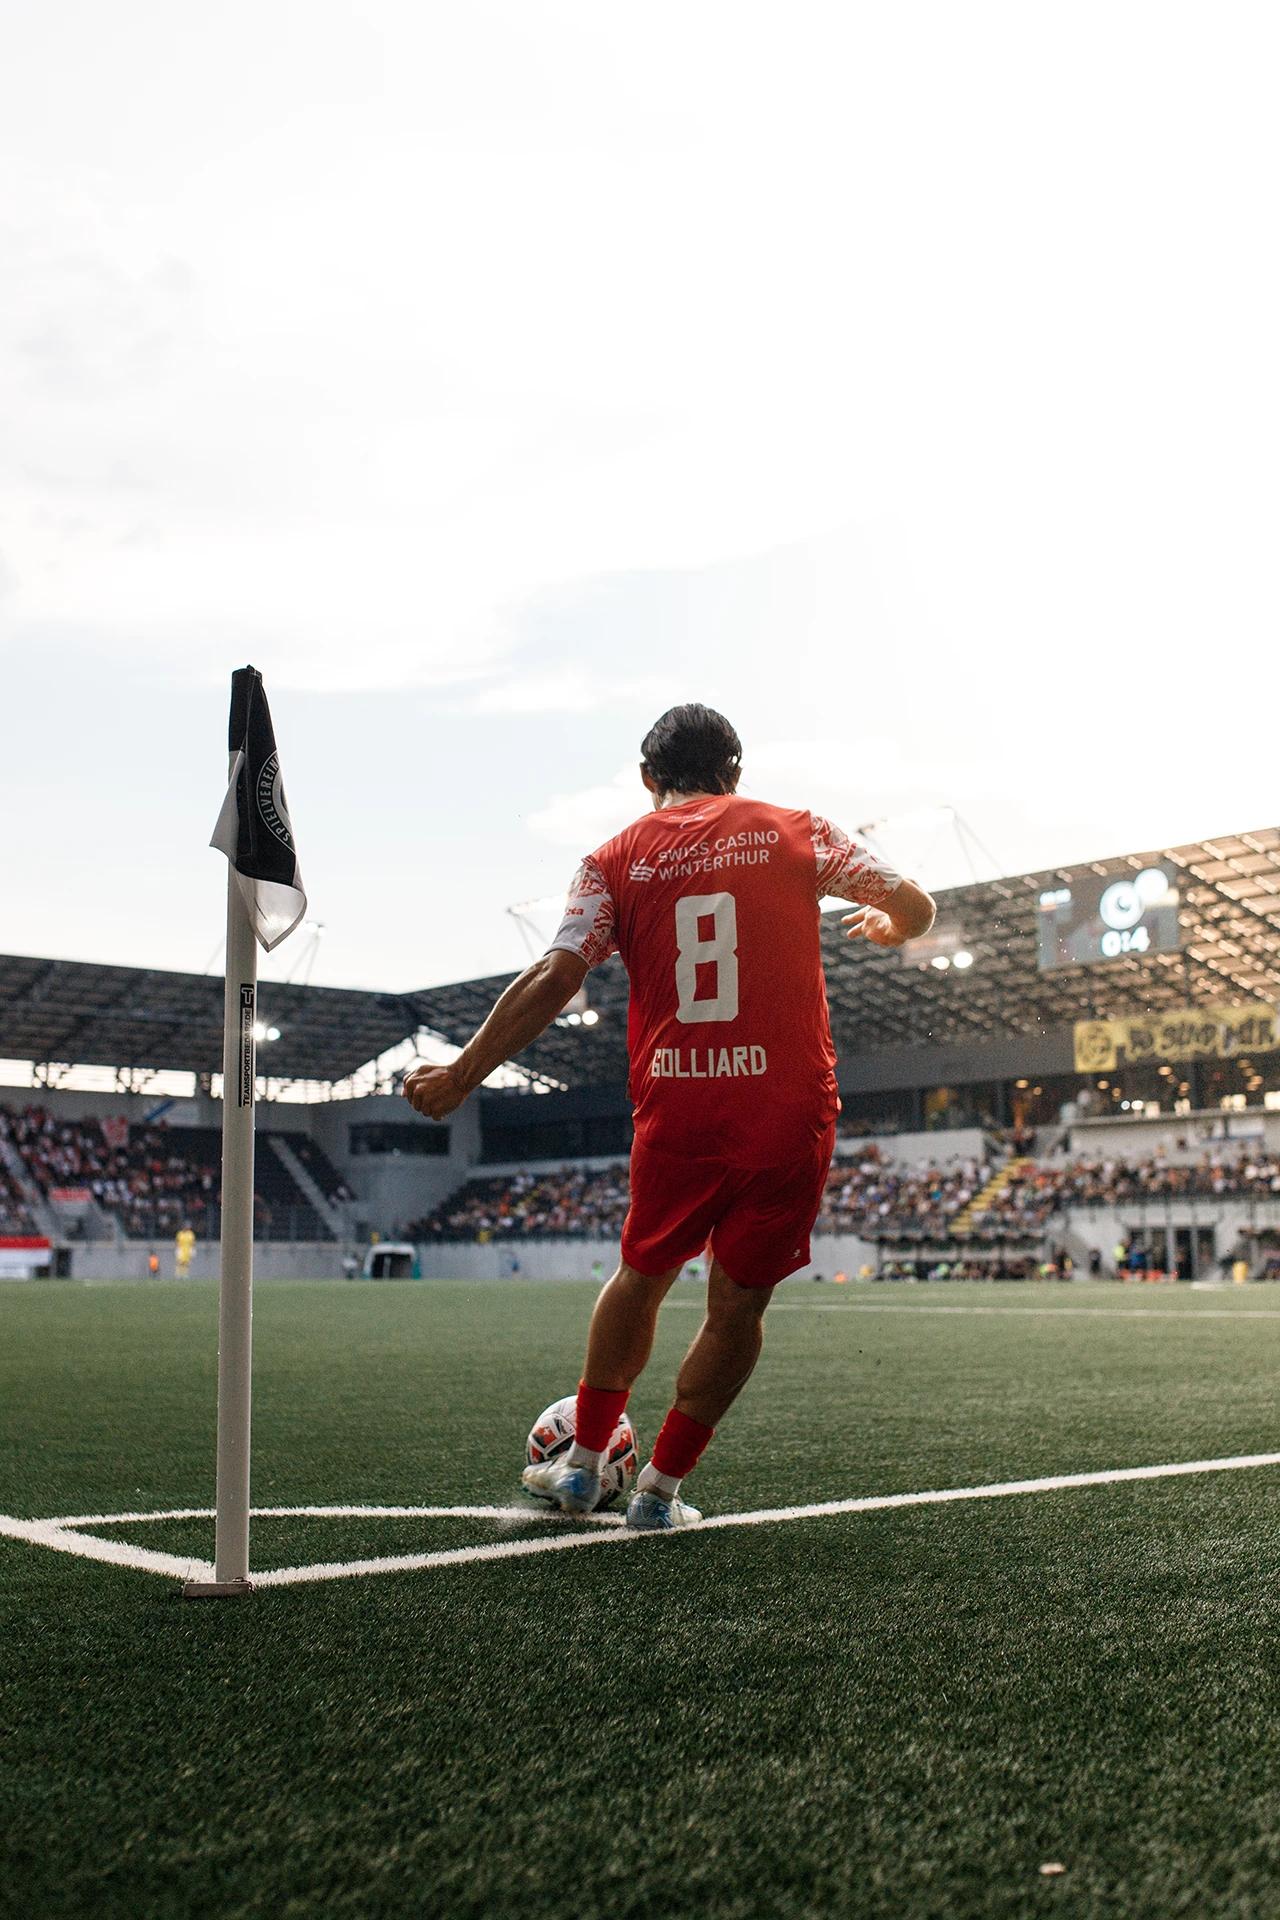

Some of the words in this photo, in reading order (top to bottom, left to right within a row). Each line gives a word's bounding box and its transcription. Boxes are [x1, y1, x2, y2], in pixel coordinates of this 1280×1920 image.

[658, 841, 709, 863] SWISS
[715, 830, 779, 851] CASINO
[658, 849, 770, 881] WINTERTHUR
[675, 891, 739, 1024] 8
[651, 1045, 767, 1078] GOLLIARD
